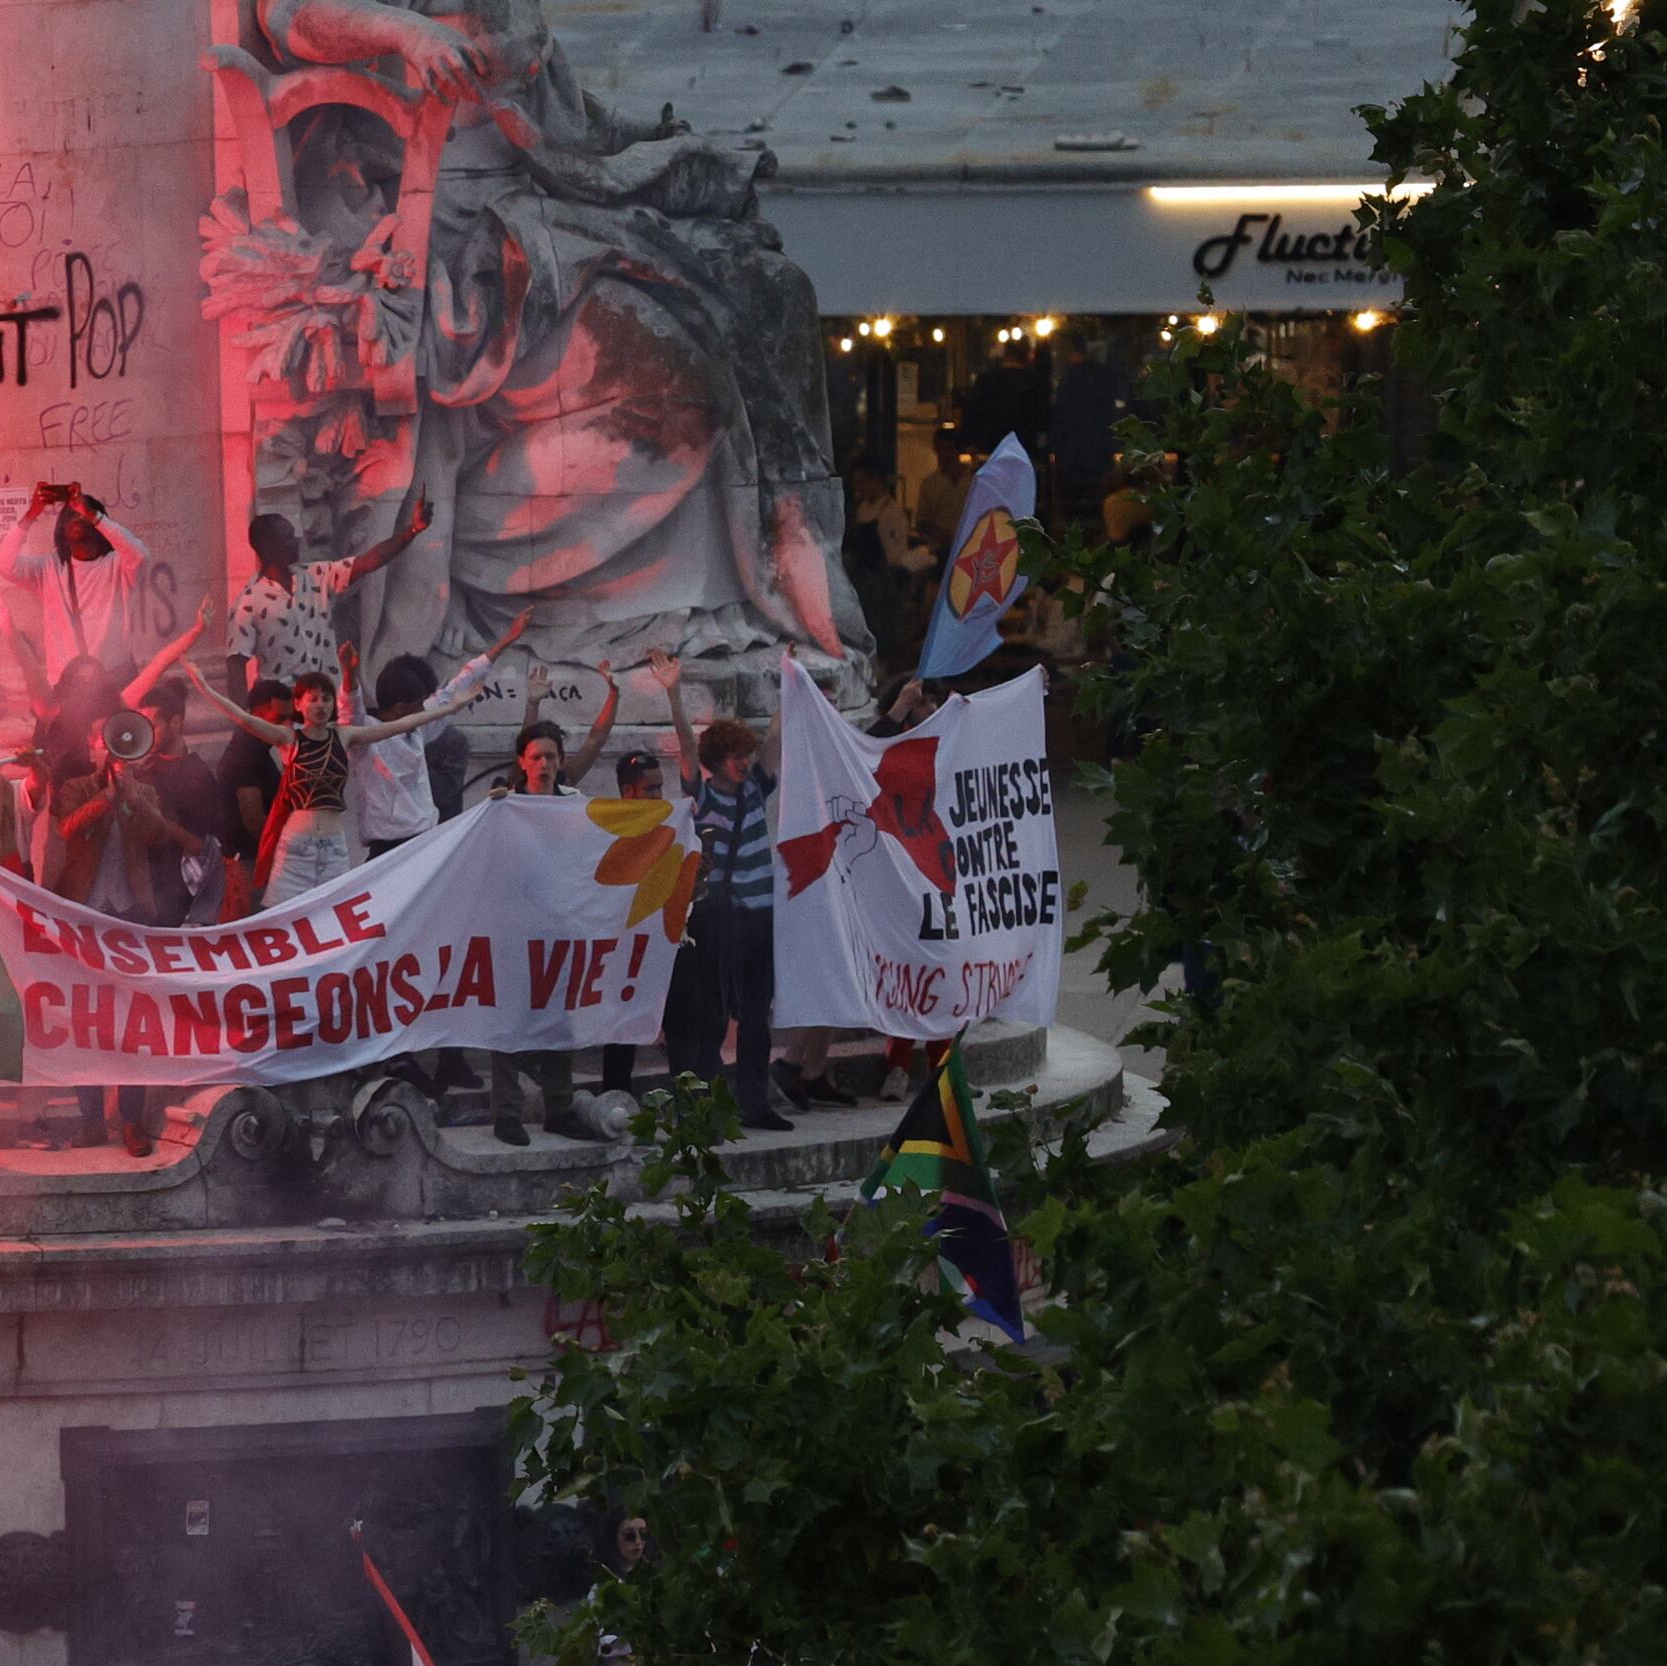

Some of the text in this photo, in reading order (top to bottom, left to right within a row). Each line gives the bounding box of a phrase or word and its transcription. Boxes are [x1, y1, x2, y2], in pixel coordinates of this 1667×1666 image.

[65, 252, 145, 389] POP
[39, 400, 133, 454] FREE
[948, 757, 1052, 828] JEUNESSE
[939, 821, 1020, 881] CONTRE
[16, 892, 387, 975] ENSEMBLE
[918, 892, 960, 940] LE
[24, 951, 426, 1056] CHANGEONS
